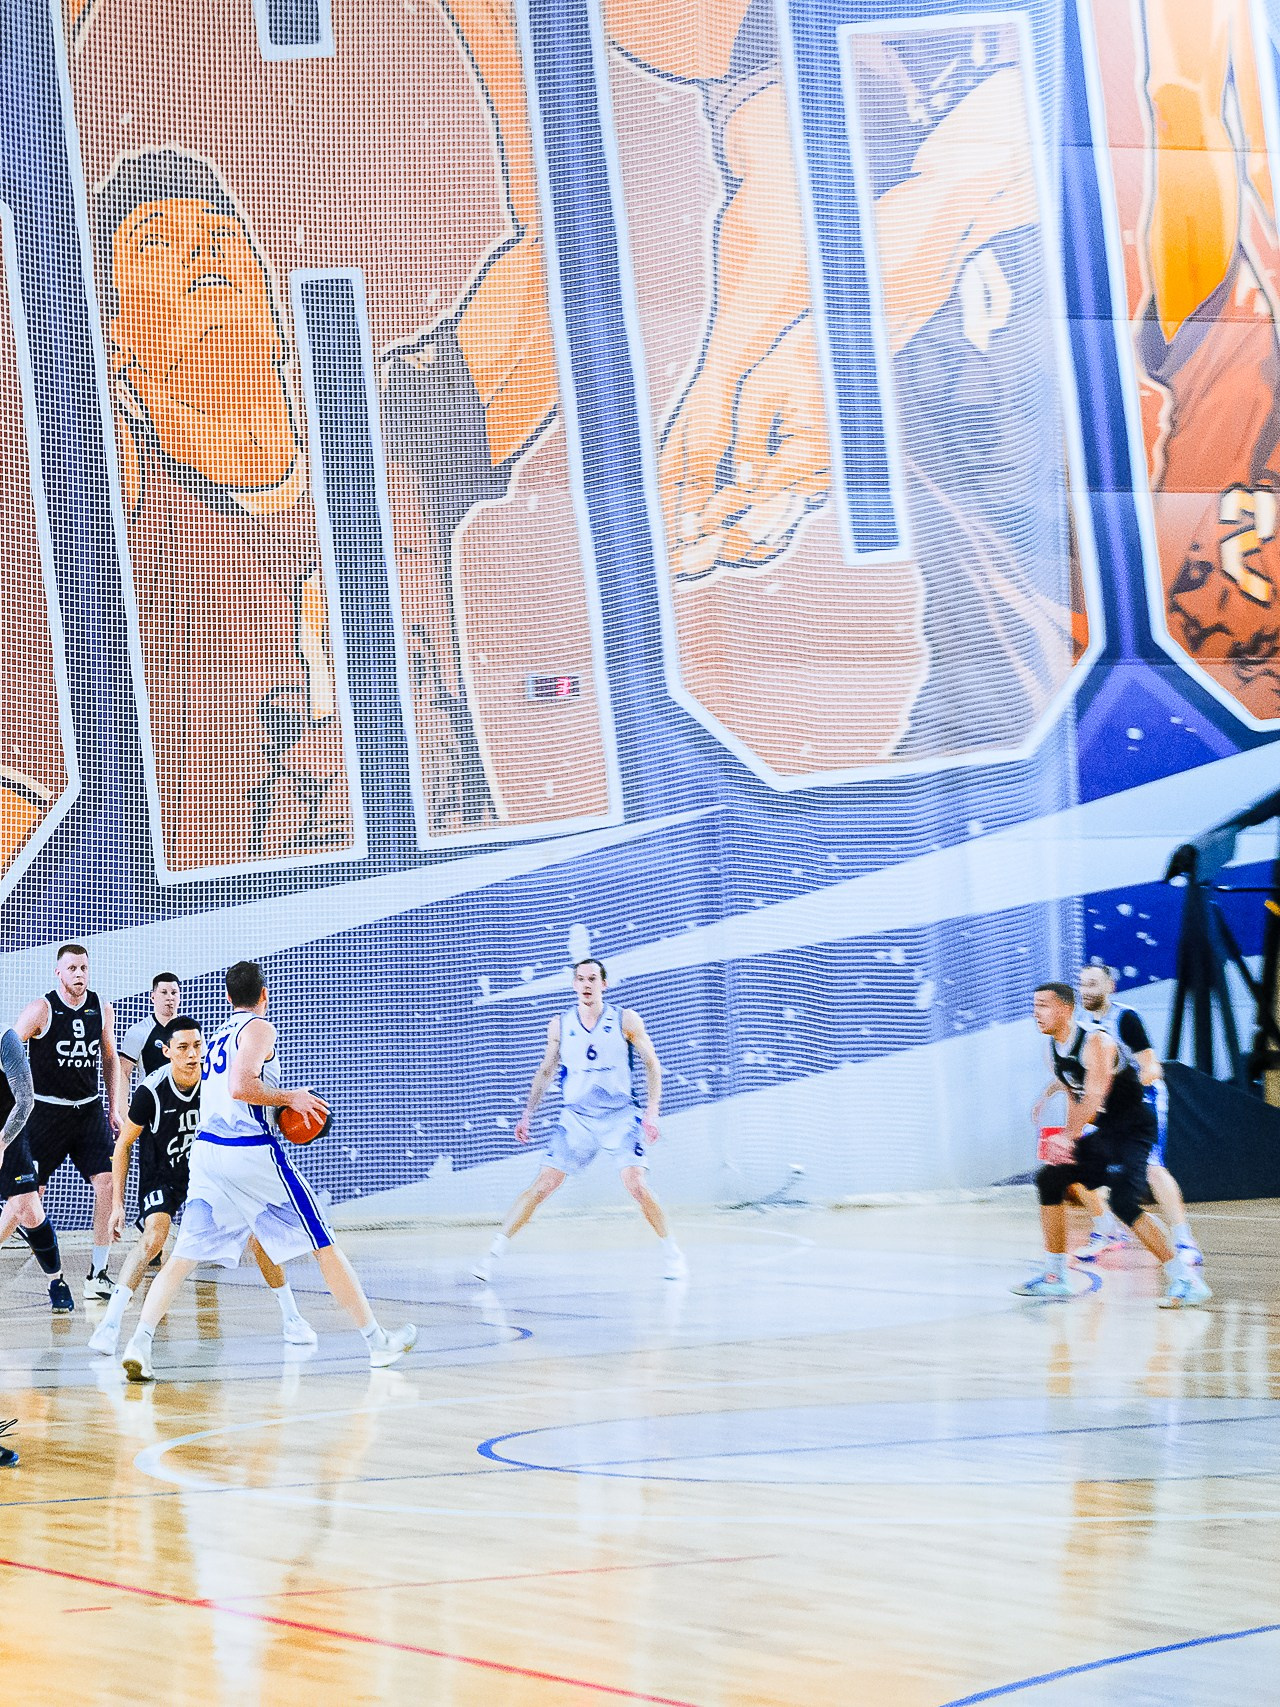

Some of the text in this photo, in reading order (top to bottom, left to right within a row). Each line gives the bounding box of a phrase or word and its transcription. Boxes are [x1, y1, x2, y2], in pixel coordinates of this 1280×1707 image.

[72, 1018, 86, 1039] 9
[56, 1039, 100, 1058] СДС
[586, 1043, 598, 1061] 6
[178, 1109, 200, 1133] 10
[143, 1189, 164, 1211] 10
